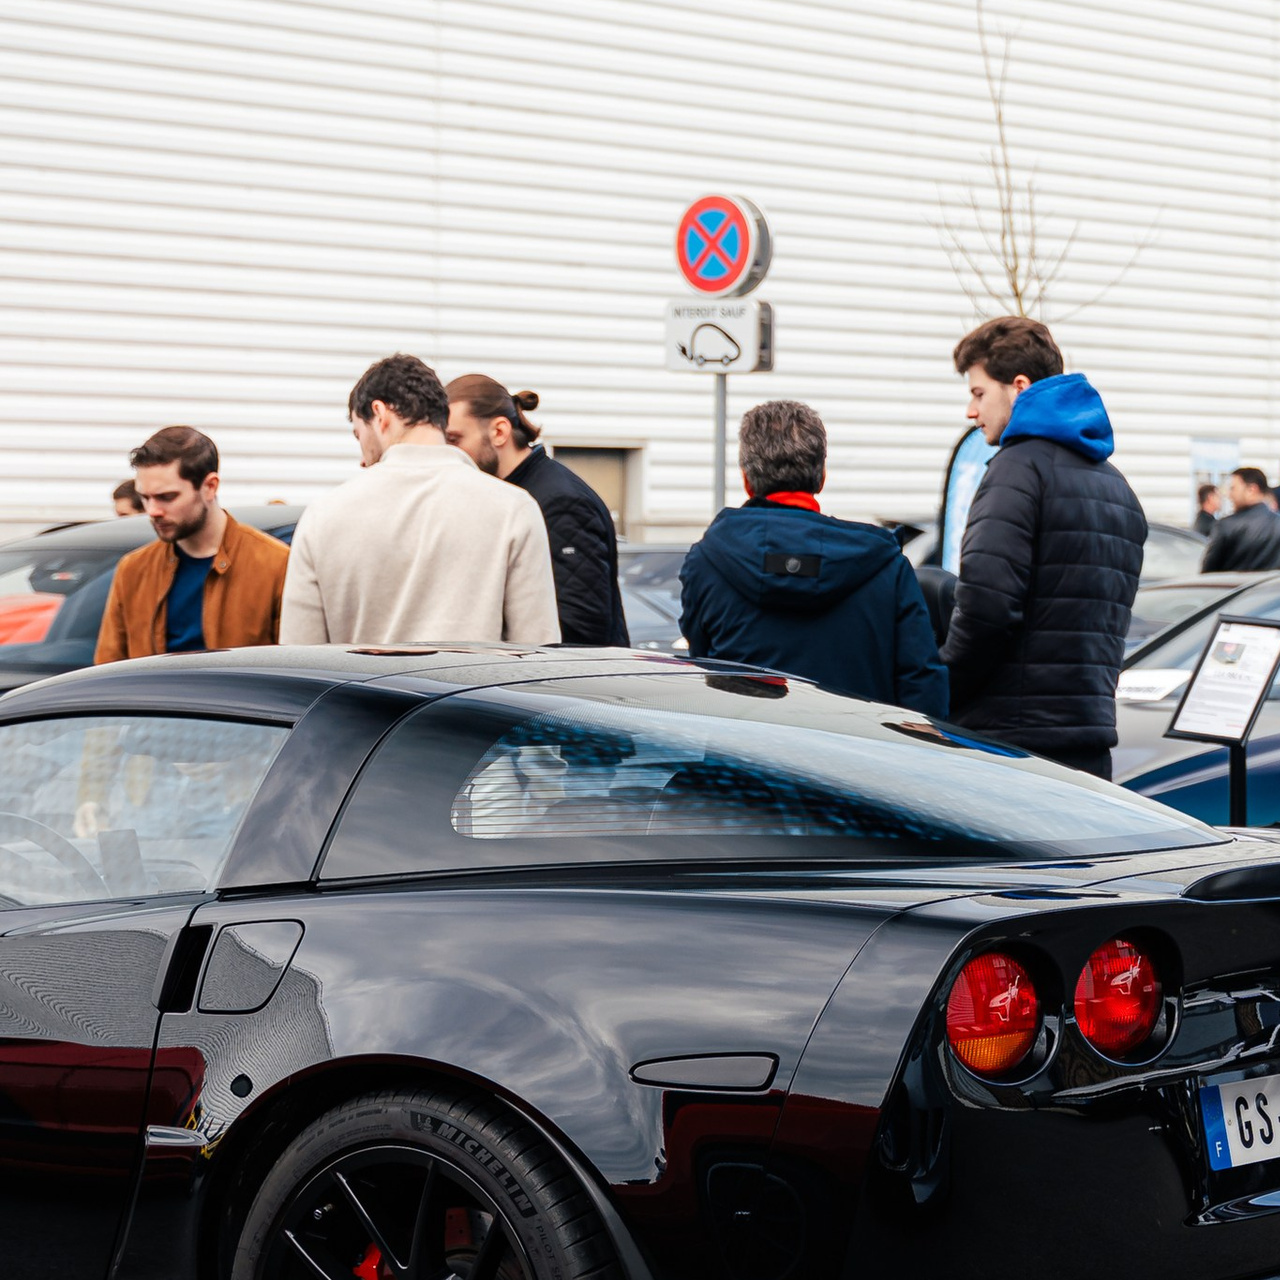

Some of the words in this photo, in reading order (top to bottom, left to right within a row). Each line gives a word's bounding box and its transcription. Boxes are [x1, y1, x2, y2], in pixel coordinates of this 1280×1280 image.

[719, 305, 746, 319] SAUF
[1215, 1141, 1223, 1158] F
[436, 1122, 533, 1210] MICHELIN
[535, 1225, 555, 1261] PILOT
